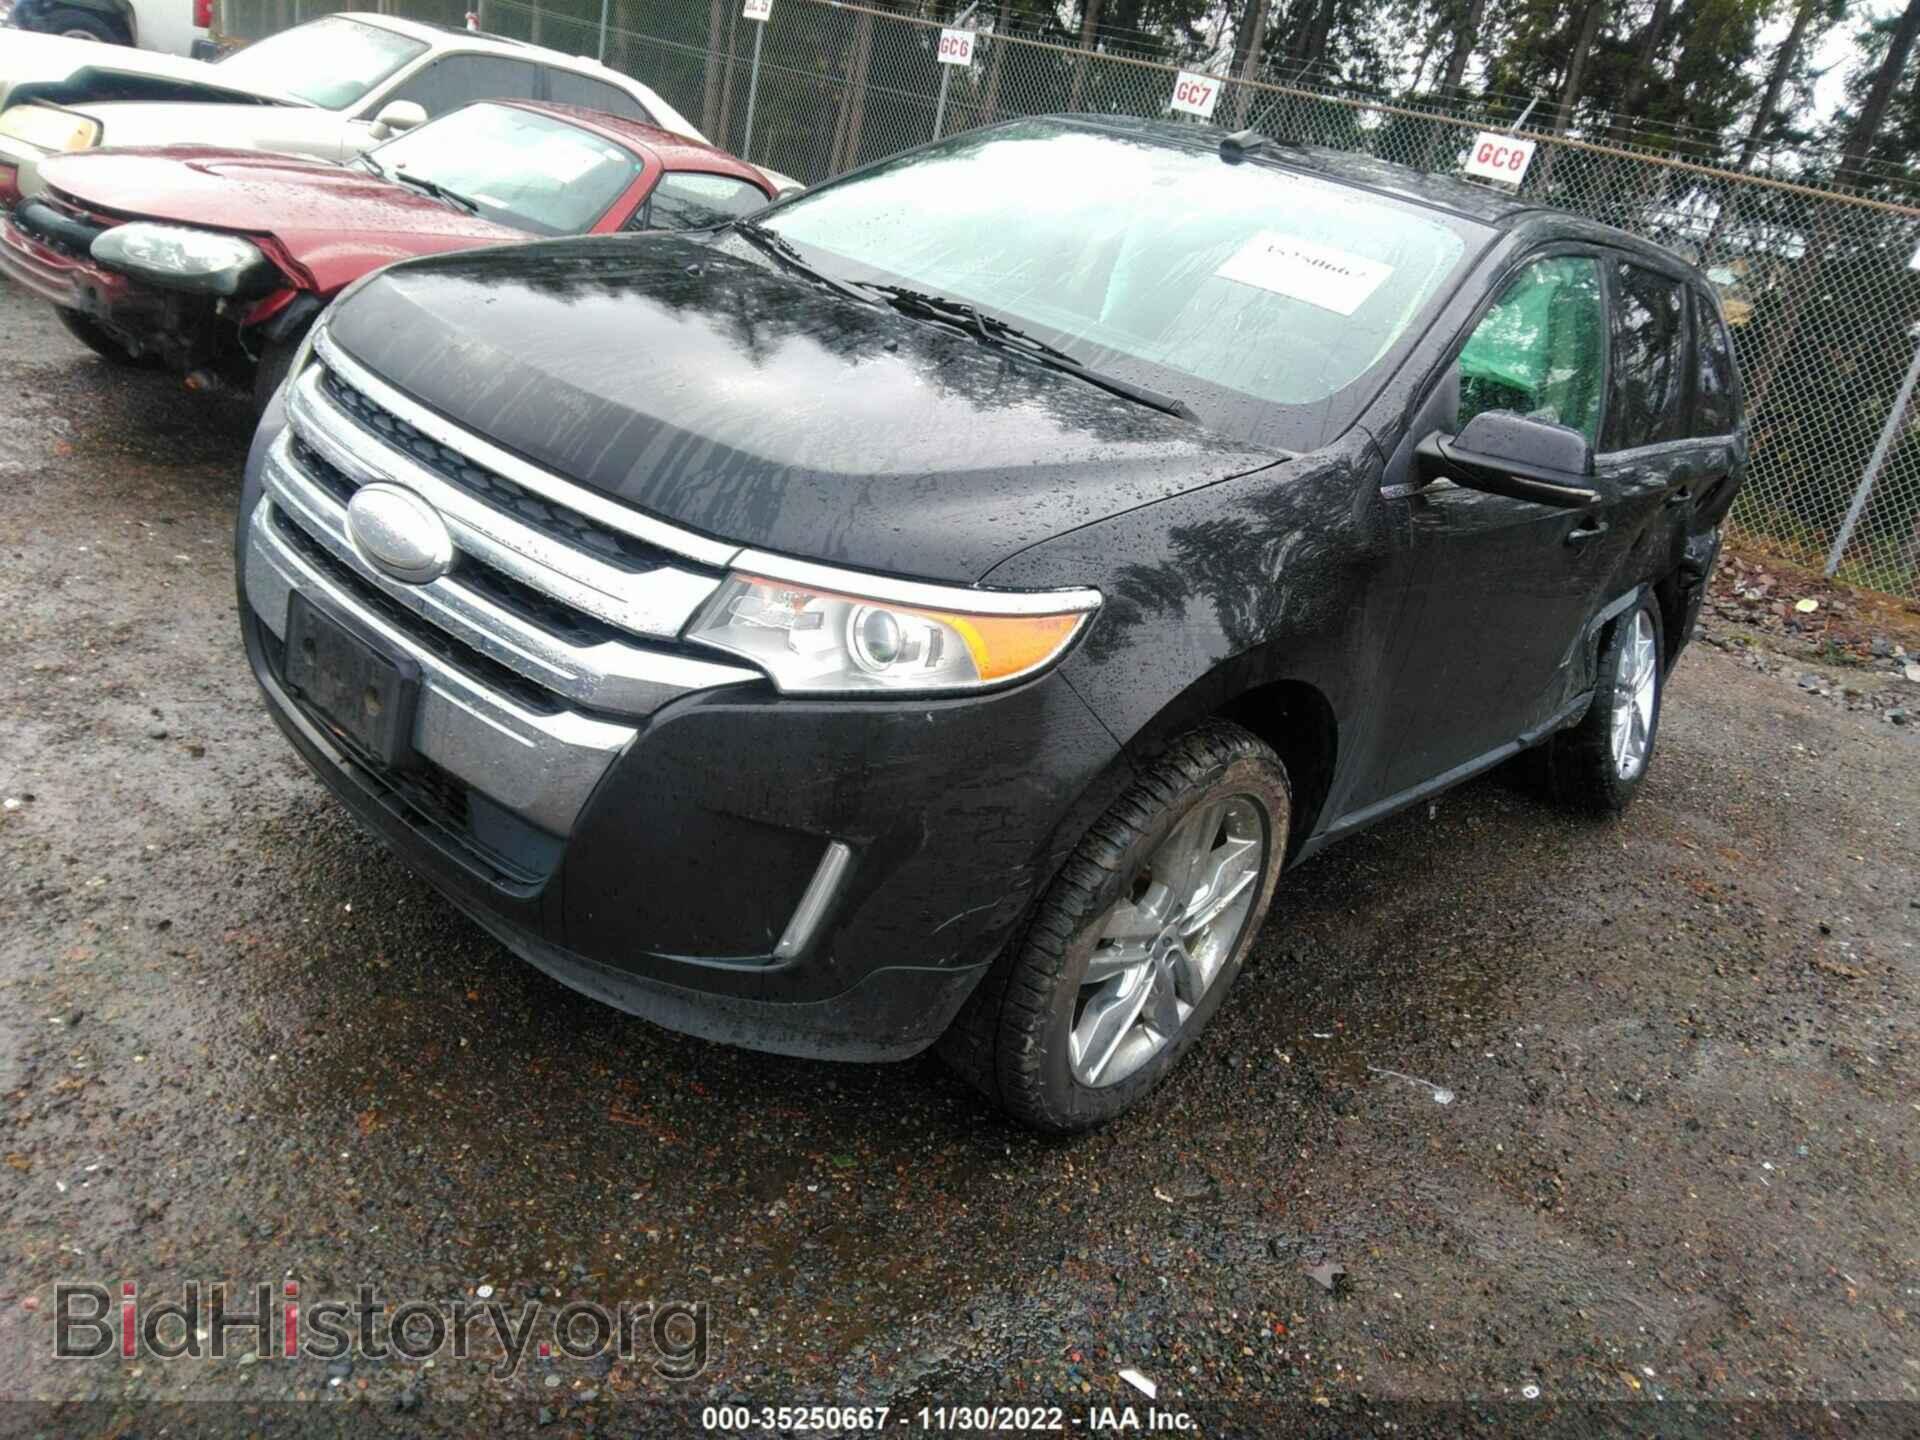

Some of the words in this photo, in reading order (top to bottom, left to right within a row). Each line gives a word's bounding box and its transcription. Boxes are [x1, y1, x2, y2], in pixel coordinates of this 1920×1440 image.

[940, 36, 969, 57] GC6
[1177, 82, 1212, 107] GC7
[1477, 143, 1525, 171] GC8
